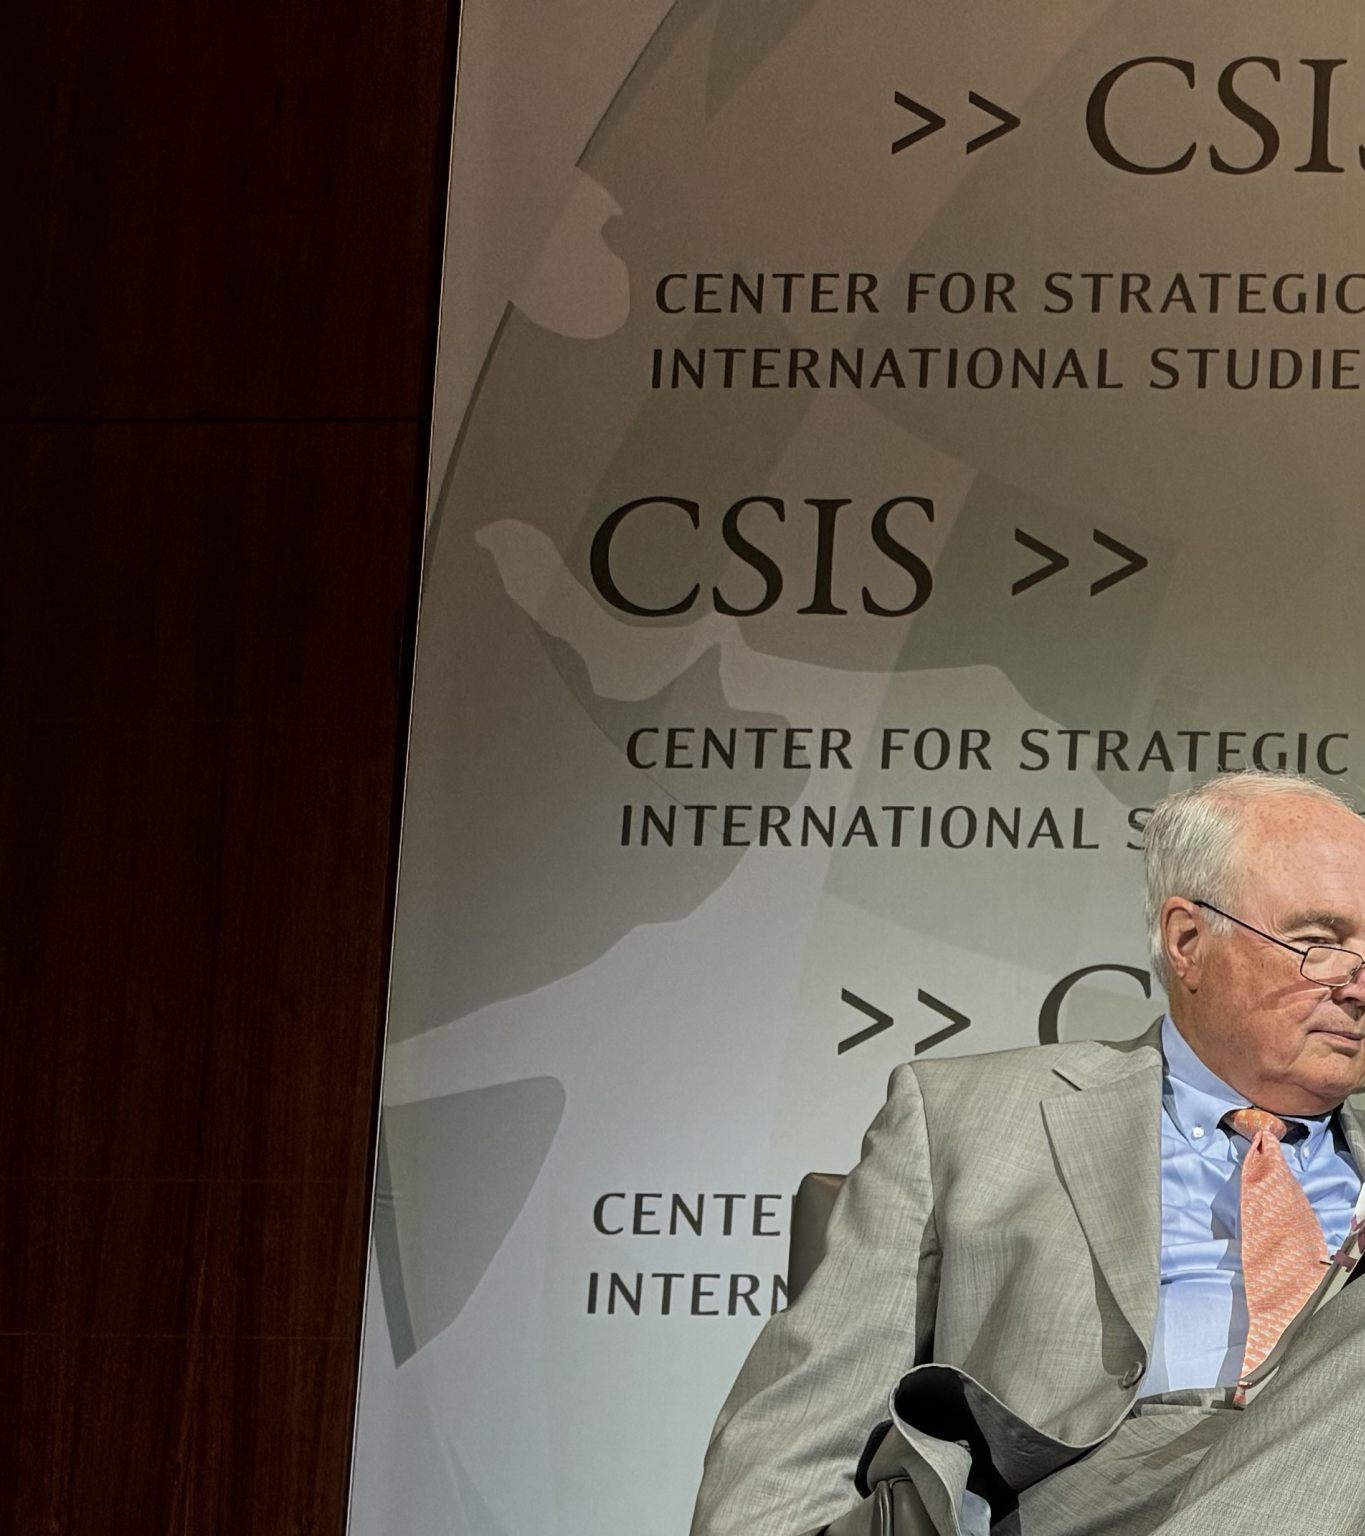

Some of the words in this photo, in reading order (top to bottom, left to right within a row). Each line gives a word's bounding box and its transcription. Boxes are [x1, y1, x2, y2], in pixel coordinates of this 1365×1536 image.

[655, 272, 880, 314] CENTER
[907, 272, 1017, 314] FOR
[651, 347, 1123, 390] INTERNATIONAL
[590, 496, 935, 617] CSIS
[626, 728, 853, 770] CENTER
[880, 728, 992, 771] FOR
[1019, 728, 1349, 775] STRATEGIC
[620, 805, 1099, 849] INTERNATIONAL
[593, 1193, 797, 1237] CENTE
